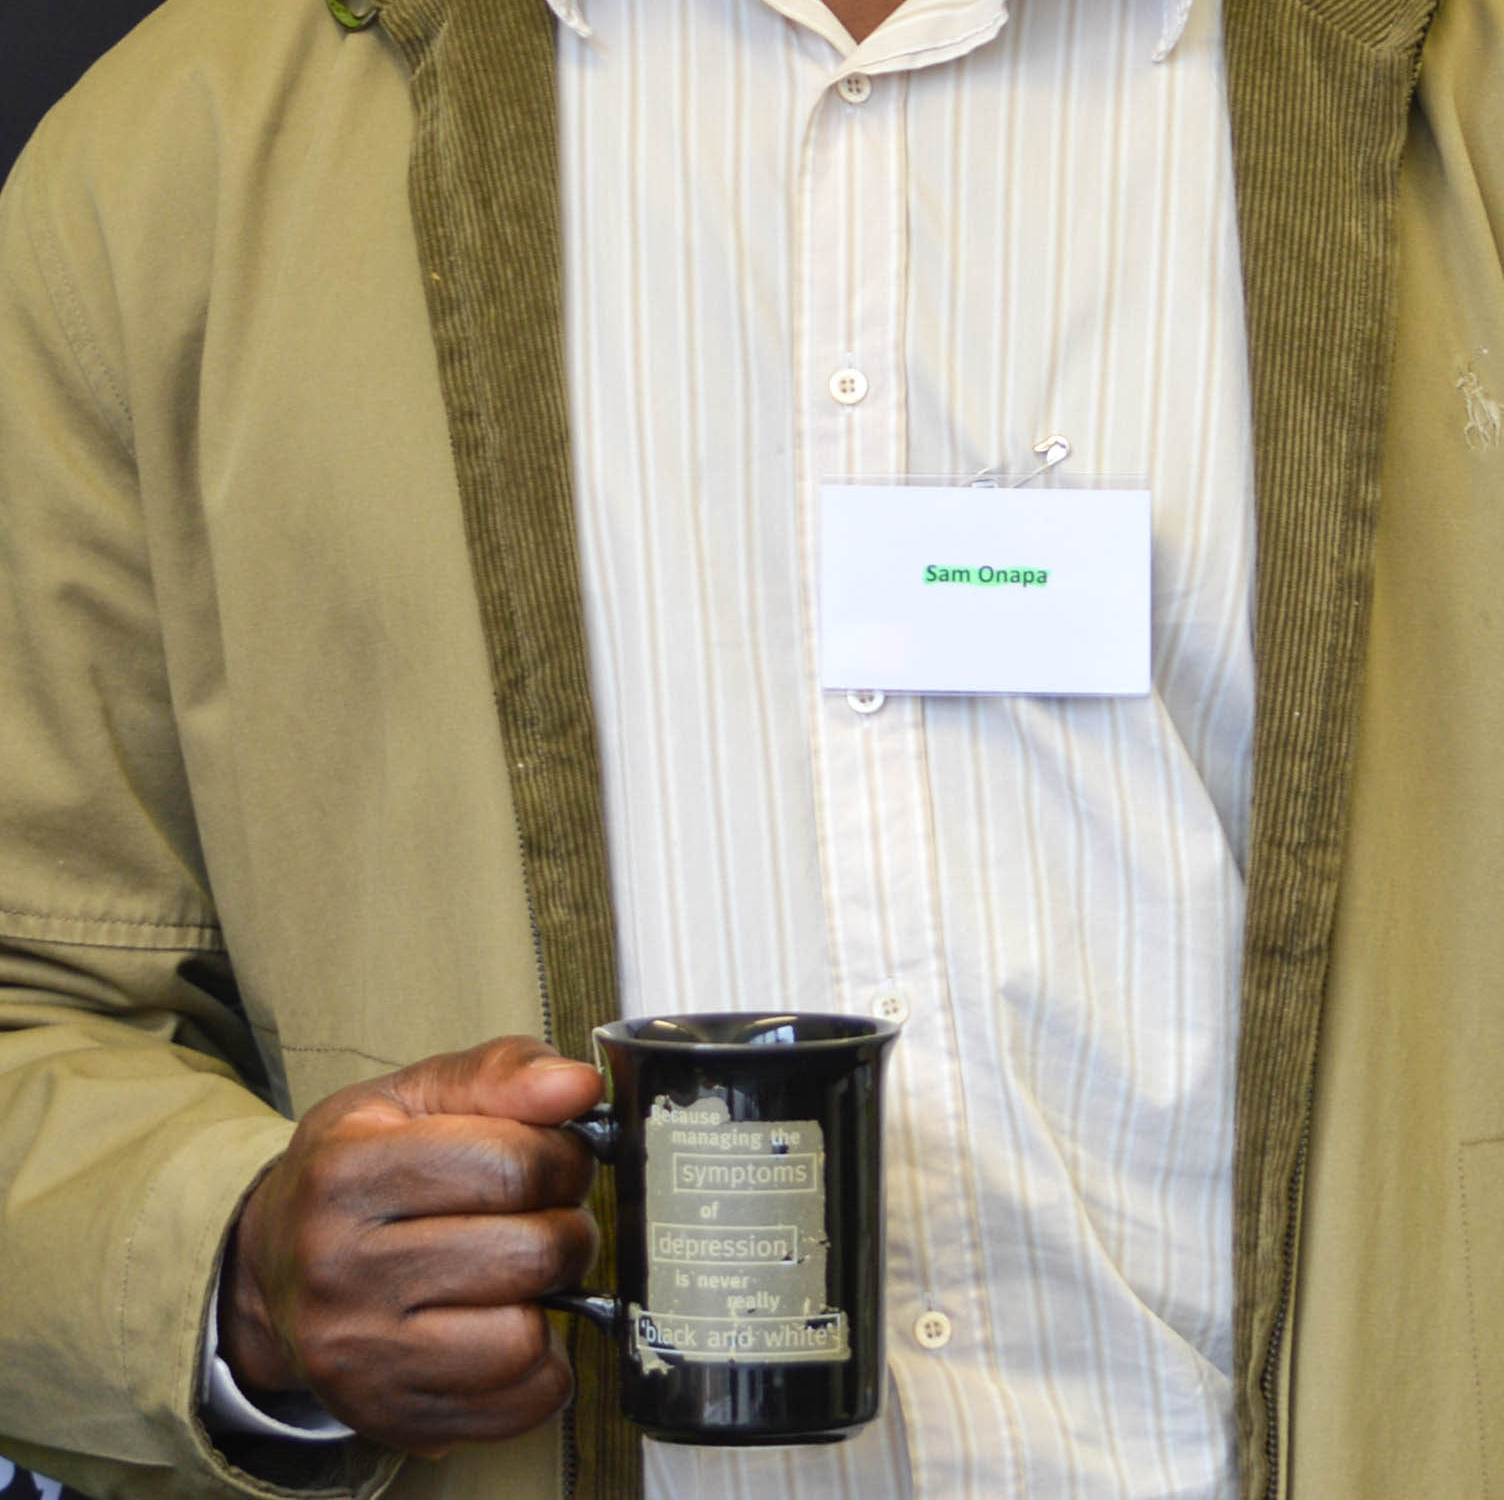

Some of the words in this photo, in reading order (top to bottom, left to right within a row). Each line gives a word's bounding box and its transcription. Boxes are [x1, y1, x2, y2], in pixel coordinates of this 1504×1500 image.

[926, 564, 971, 583] Sam
[978, 565, 1048, 588] Onapa
[672, 1128, 762, 1150] managing
[770, 1128, 801, 1147] the
[682, 1162, 808, 1188] symptoms
[700, 1201, 719, 1219] of
[658, 1231, 788, 1261] depression
[676, 1269, 690, 1288] is
[697, 1274, 750, 1289] never
[727, 1292, 781, 1313] really
[707, 1325, 753, 1348] and
